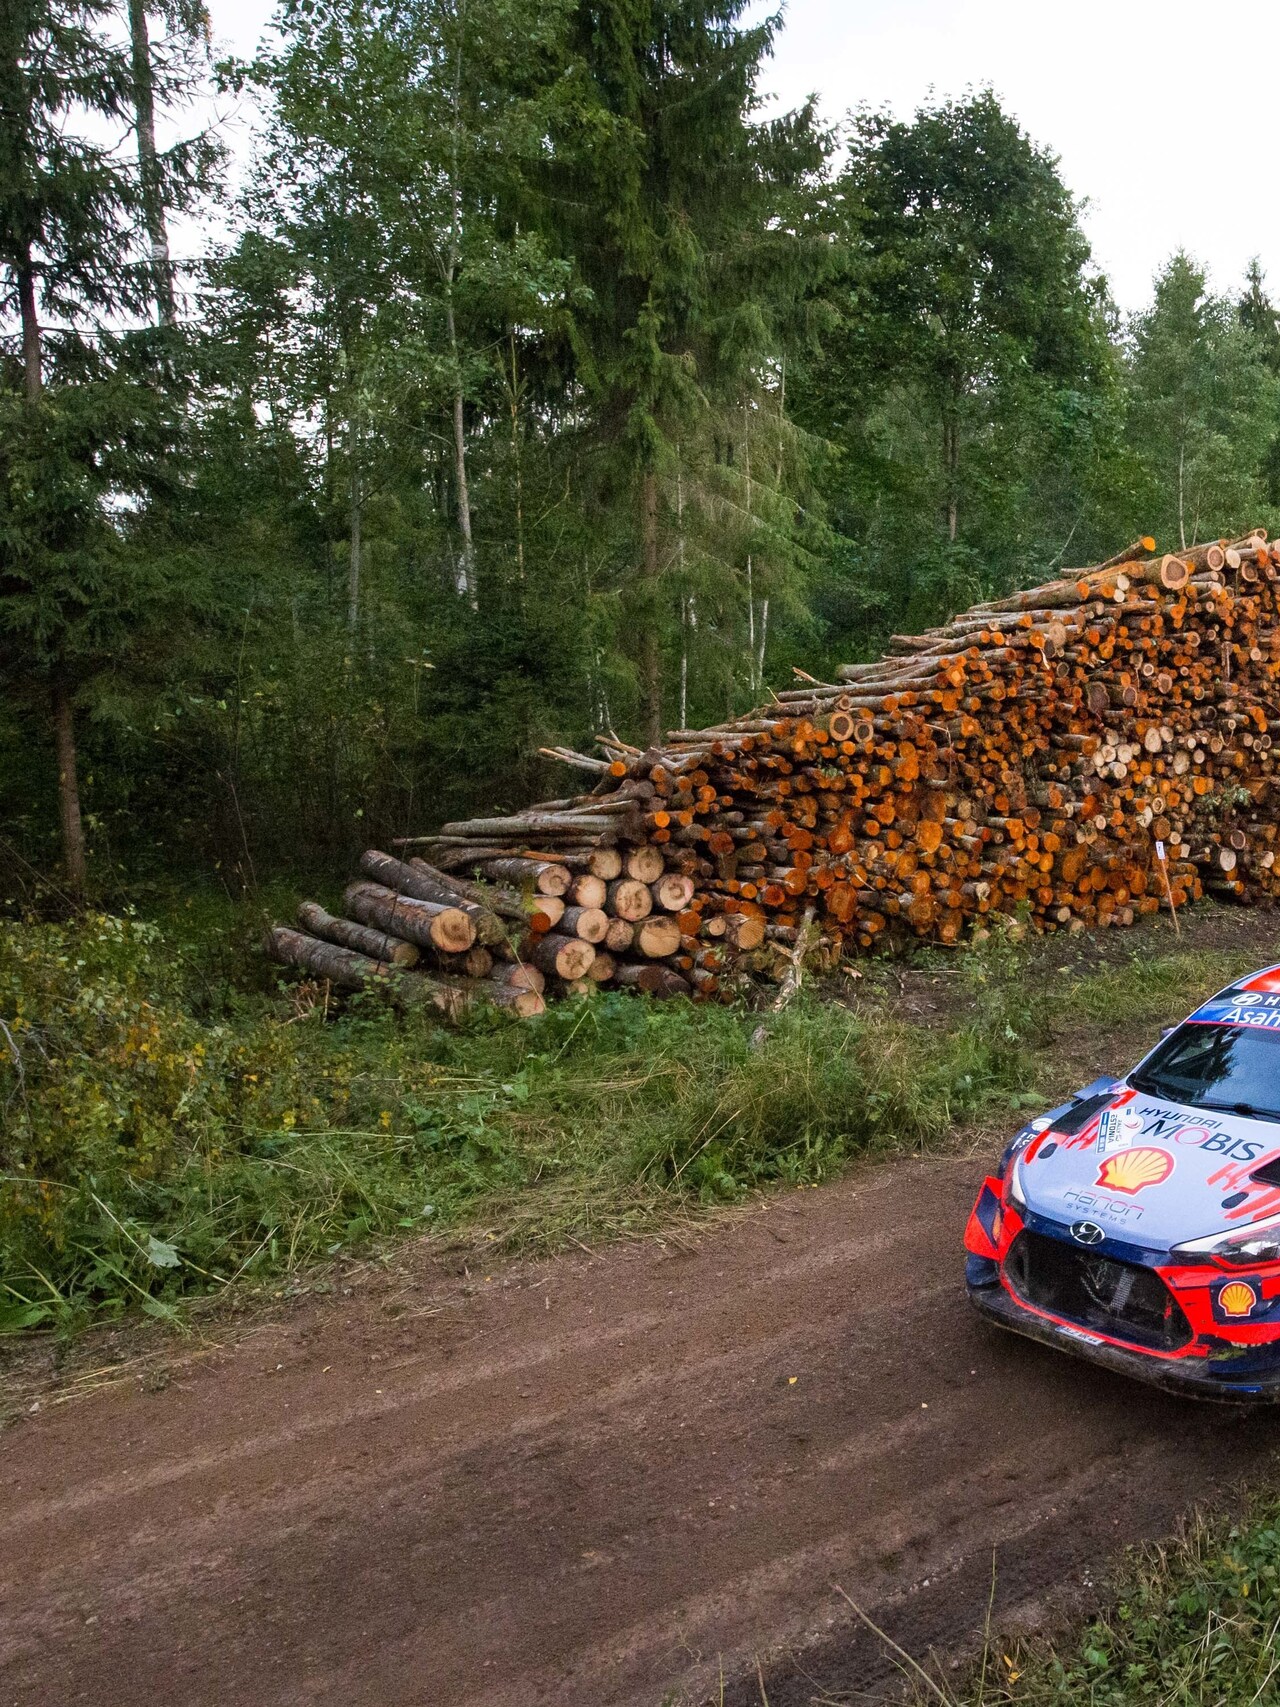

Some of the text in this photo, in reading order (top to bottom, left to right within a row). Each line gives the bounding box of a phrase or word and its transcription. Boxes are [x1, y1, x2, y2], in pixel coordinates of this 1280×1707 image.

[1108, 1114, 1118, 1144] ESTONIA
[1139, 1107, 1223, 1129] HYUNDAI
[1141, 1119, 1265, 1161] MOBIS
[1066, 1202, 1127, 1225] SYSTEMS
